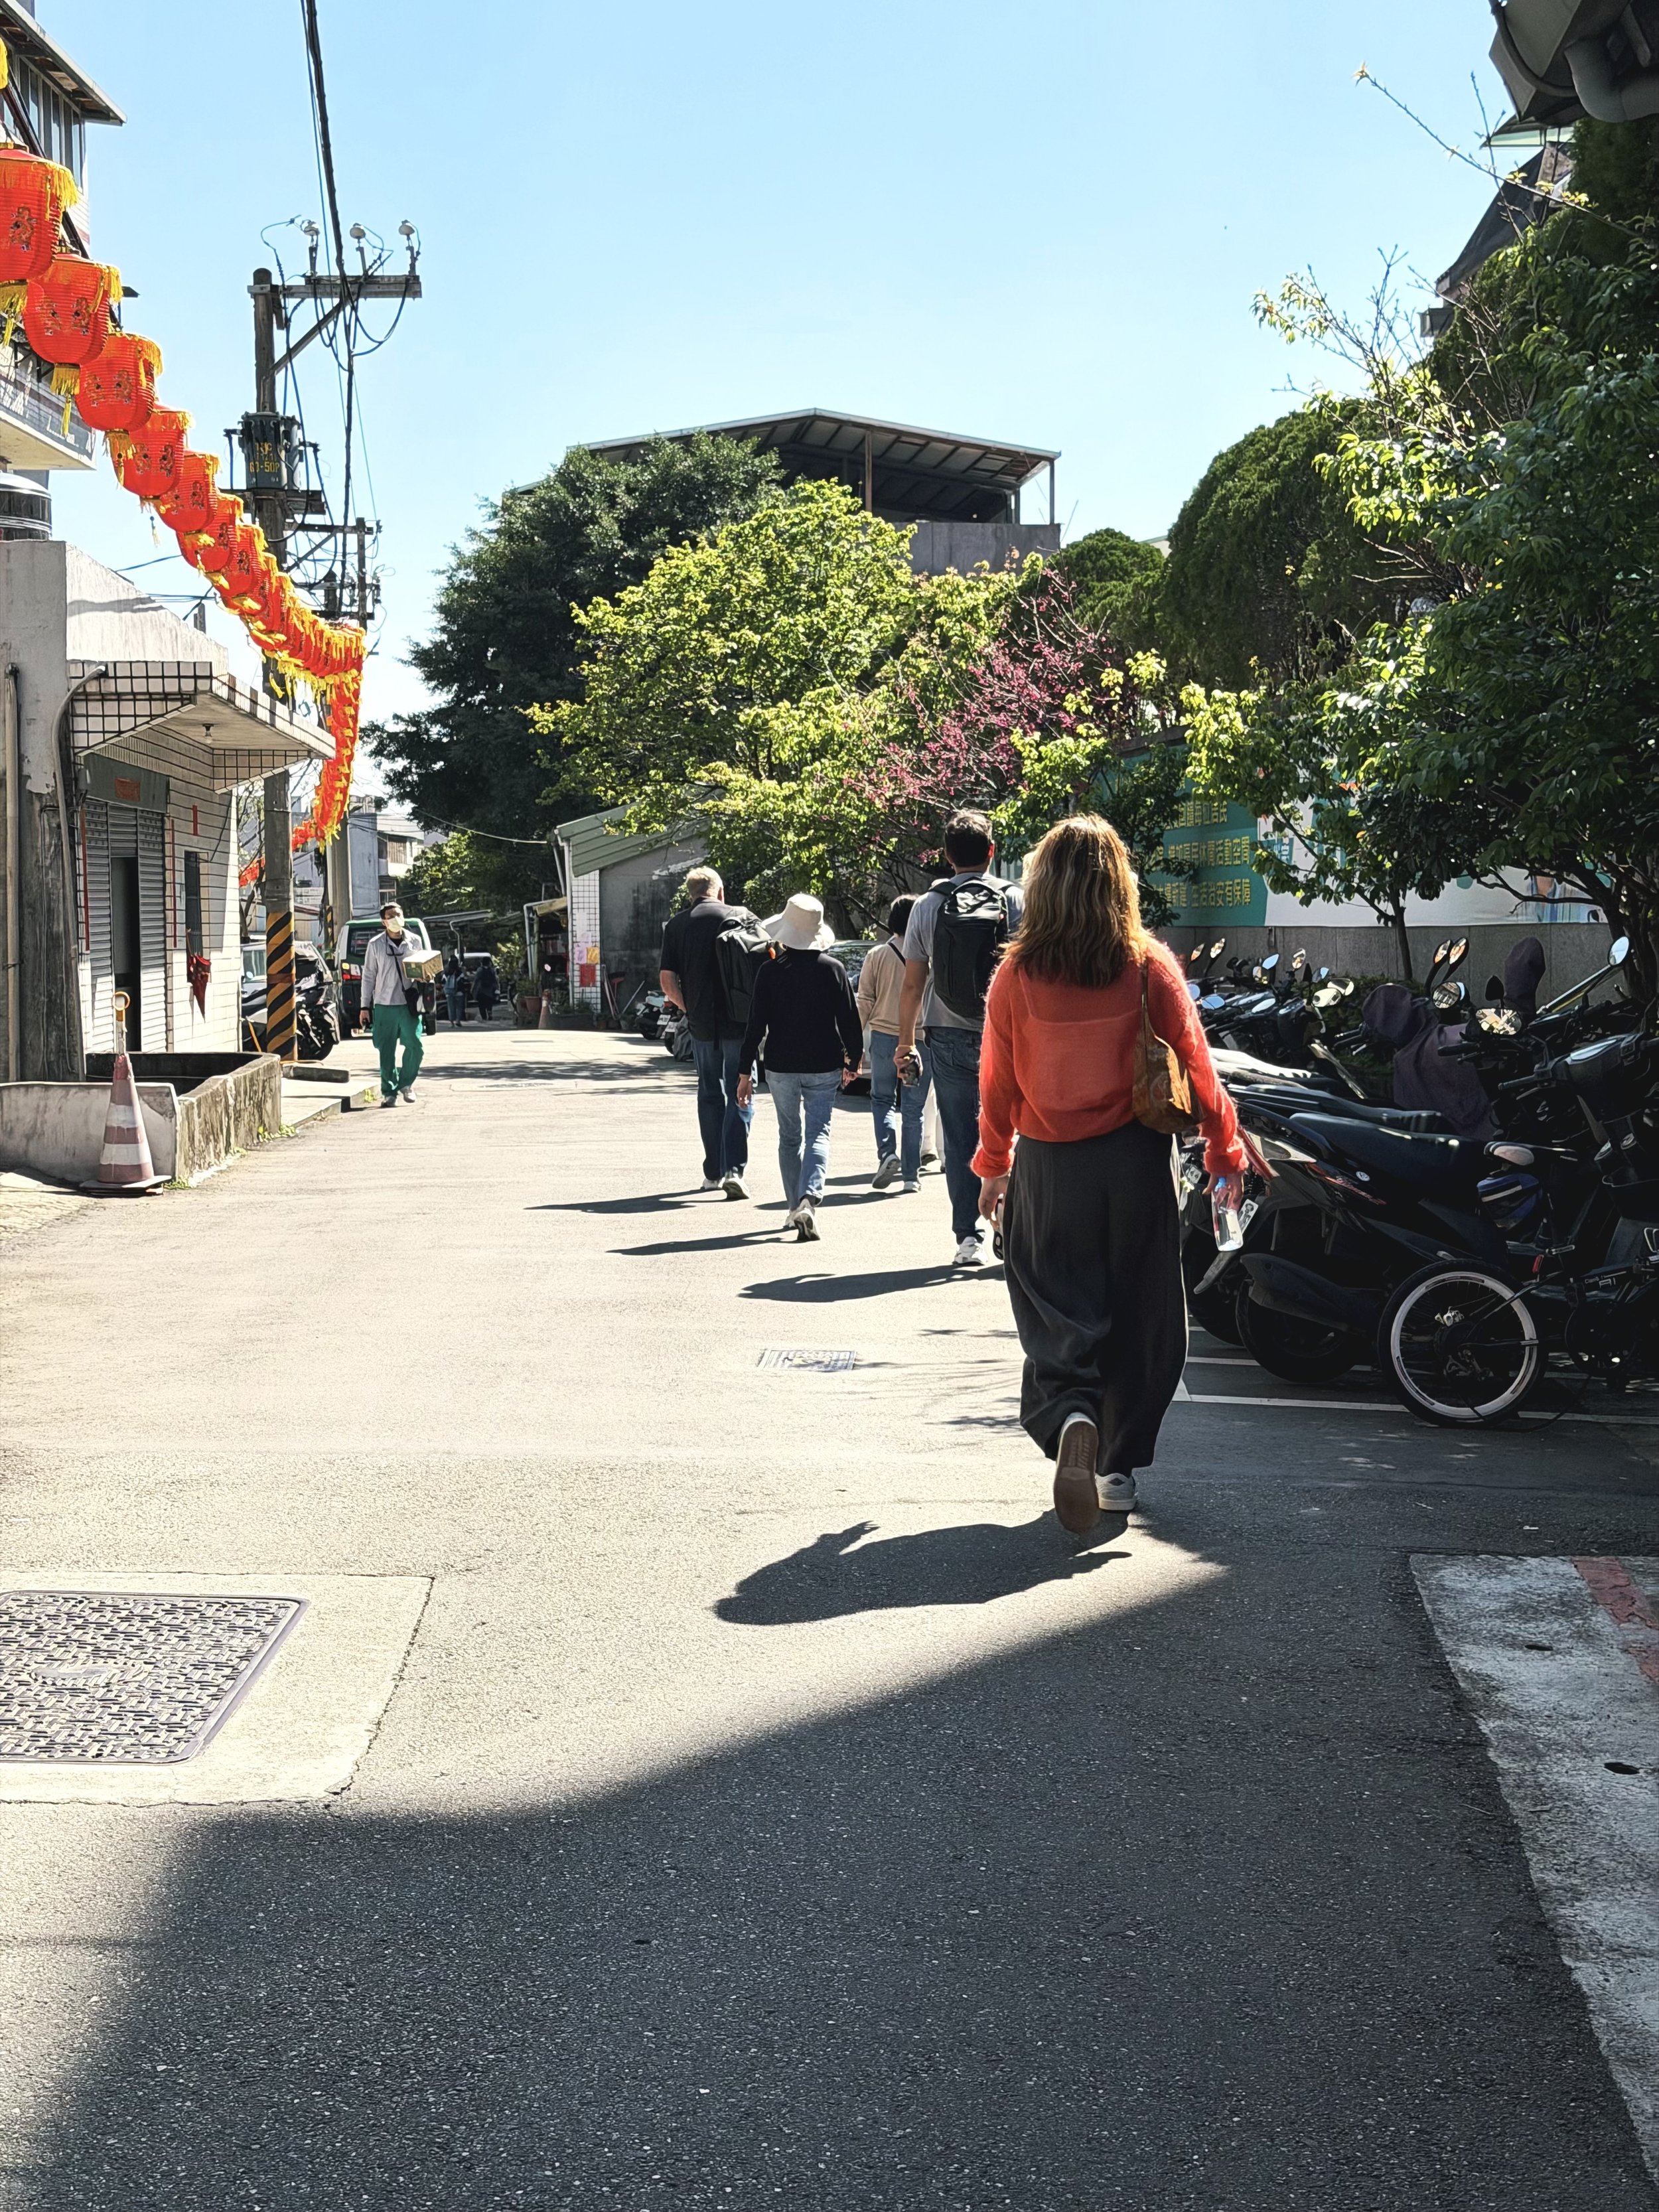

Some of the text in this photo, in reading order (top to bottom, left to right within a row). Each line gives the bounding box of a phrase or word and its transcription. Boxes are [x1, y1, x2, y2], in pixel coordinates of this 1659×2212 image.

[1191, 878, 1251, 907] 生活治安有保障
